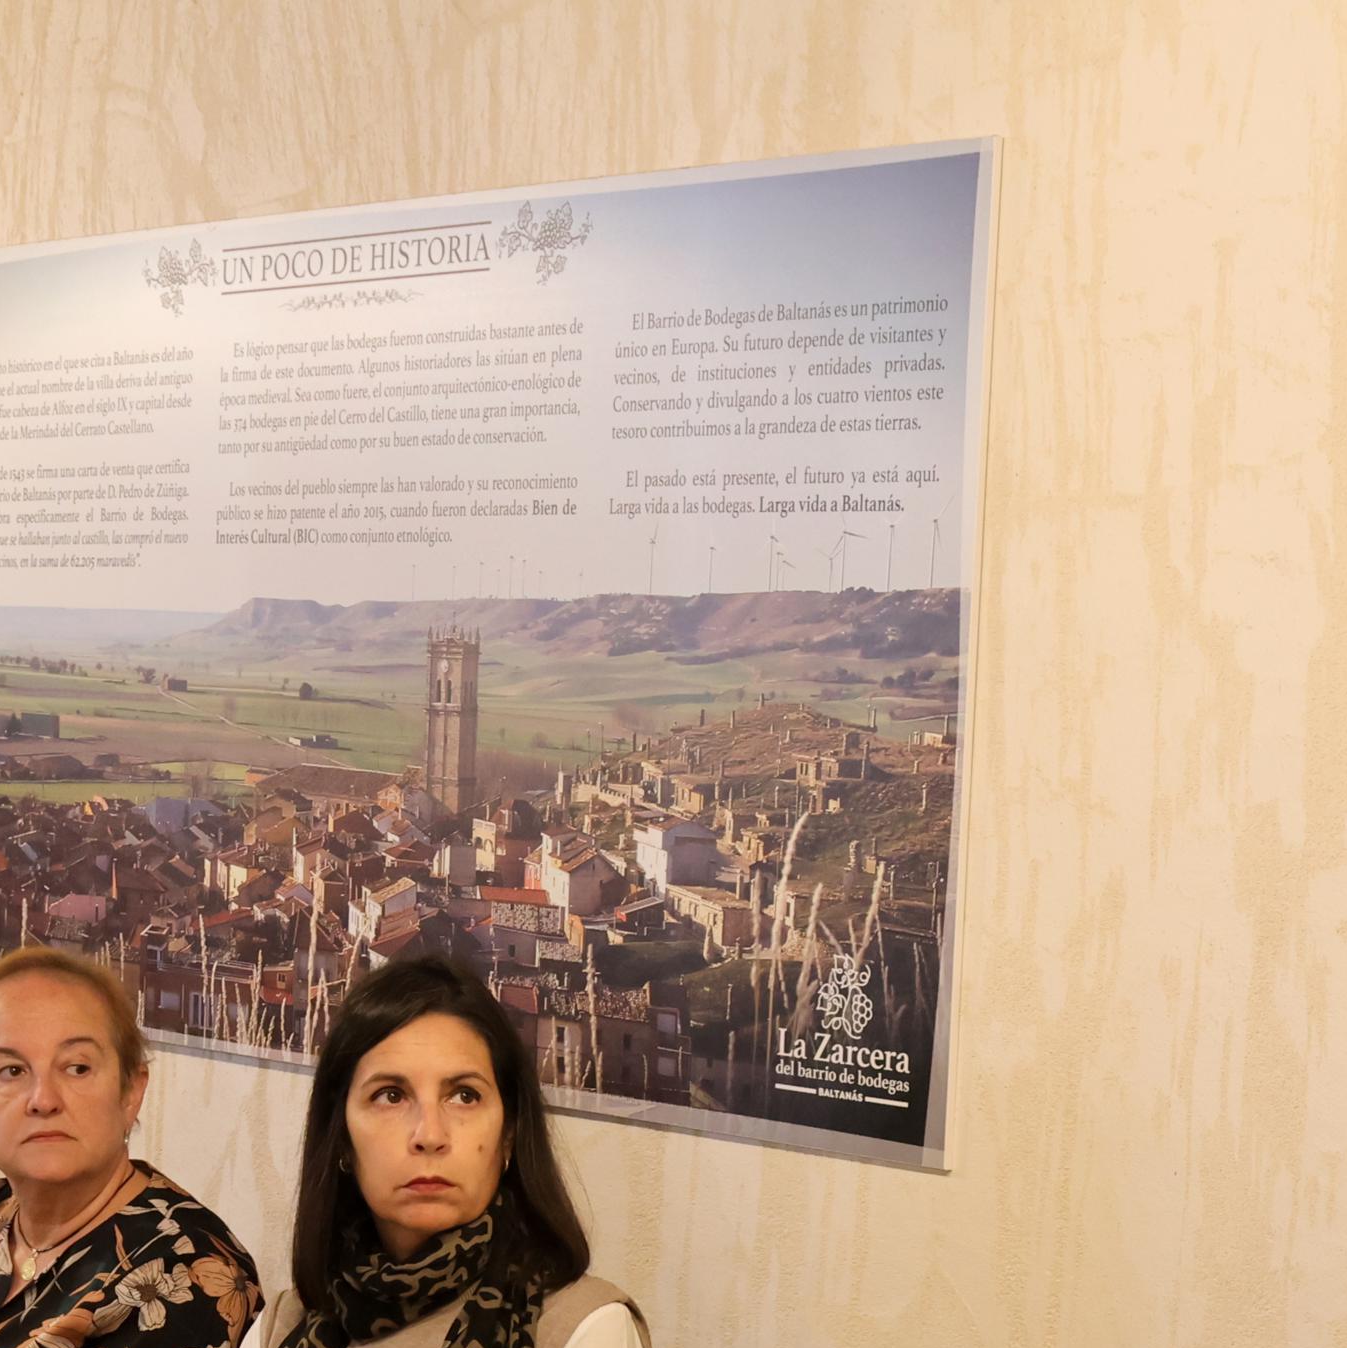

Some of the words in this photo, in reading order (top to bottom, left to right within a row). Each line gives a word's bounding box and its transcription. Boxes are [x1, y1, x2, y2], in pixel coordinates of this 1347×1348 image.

[222, 256, 254, 285] UN
[261, 249, 323, 281] POCO
[331, 245, 363, 275] DE
[370, 233, 490, 271] HISTORIA
[632, 312, 645, 330] El
[648, 312, 684, 329] Barrio
[686, 309, 702, 326] de
[705, 308, 755, 329] Bodegas
[757, 305, 774, 322] de
[777, 302, 831, 321] Baltanás
[833, 306, 848, 317] es
[850, 304, 868, 316] un
[872, 295, 948, 321] patrimonio
[233, 343, 245, 358] Es
[245, 341, 275, 361] lógico
[276, 342, 309, 359] pensar
[309, 341, 329, 357] que
[331, 335, 345, 351] las
[346, 333, 388, 352] bodegas
[389, 331, 424, 347] fueron
[489, 324, 535, 339] bastante
[537, 324, 567, 336] antes
[569, 319, 584, 334] de
[616, 342, 648, 358] único
[651, 344, 667, 356] en
[672, 338, 717, 358] Europa.
[723, 336, 739, 352] Su
[744, 334, 783, 351] futuro
[788, 329, 844, 353] depende
[848, 328, 866, 345] de
[870, 326, 933, 344] visitantes
[938, 329, 947, 346] y
[220, 367, 229, 383] la
[231, 366, 258, 381] firma
[260, 364, 273, 380] de
[275, 368, 295, 379] este
[297, 362, 355, 378] documento.
[357, 358, 401, 378] Algunos
[404, 353, 472, 371] historiadores
[476, 351, 491, 366] las
[494, 349, 529, 365] sitúan
[532, 353, 546, 363] en
[550, 347, 583, 367] plena
[615, 368, 660, 385] vecinos,
[670, 365, 687, 382] de
[698, 363, 776, 381] instituciones
[788, 365, 797, 382] y
[808, 357, 871, 376] entidades
[885, 354, 944, 378] privadas.
[219, 392, 247, 411] época
[247, 387, 293, 405] medieval.
[294, 387, 312, 402] Sea
[313, 390, 341, 401] como
[342, 384, 371, 399] fuere,
[372, 382, 382, 398] el
[383, 382, 430, 399] conjunto
[567, 372, 582, 387] de
[613, 393, 691, 412] Conservando
[695, 398, 703, 414] y
[708, 389, 777, 412] divulgando
[781, 394, 789, 405] a
[794, 388, 813, 405] los
[817, 391, 858, 404] cuatro
[864, 385, 911, 402] vientos
[917, 387, 943, 400] este
[612, 427, 647, 439] tesoro
[650, 419, 731, 438] contribuimos
[734, 424, 741, 435] a
[744, 418, 756, 435] la
[759, 417, 816, 440] grandeza
[819, 416, 837, 432] de
[840, 419, 871, 432] estas
[876, 414, 921, 430] tierras.
[218, 443, 243, 454] tanto
[243, 442, 260, 457] por
[261, 442, 273, 452] su
[273, 434, 329, 455] antigüedad
[329, 439, 358, 449] como
[359, 438, 378, 453] por
[379, 437, 391, 448] su
[393, 432, 419, 447] buen
[421, 430, 456, 446] estado
[457, 430, 471, 444] de
[626, 470, 639, 487] El
[645, 470, 686, 492] pasado
[693, 469, 715, 486] está
[723, 473, 778, 491] presente,
[784, 467, 797, 484] el
[804, 467, 844, 484] futuro
[850, 472, 866, 488] ya
[873, 466, 898, 483] está
[906, 465, 939, 488] aquí.
[215, 505, 251, 525] público
[253, 510, 264, 520] se
[266, 504, 288, 519] hizo
[289, 508, 326, 524] patente
[328, 503, 339, 519] el
[341, 504, 361, 518] año
[389, 502, 429, 517] cuando
[431, 501, 467, 517] fueron
[470, 500, 529, 516] declaradas
[532, 500, 558, 515] Bien
[562, 499, 577, 515] de
[610, 498, 641, 519] Larga
[645, 497, 669, 514] vida
[672, 503, 679, 513] a
[682, 496, 699, 514] las
[703, 496, 755, 518] bodegas.
[760, 496, 795, 518] Larga
[799, 495, 826, 512] vida
[830, 501, 838, 512] a
[843, 494, 904, 511] Baltanás.
[215, 530, 250, 544] Interés
[250, 528, 292, 544] Cultural
[293, 528, 319, 544] (BIC)
[320, 533, 349, 543] como
[349, 528, 395, 545] conjunto
[396, 527, 453, 547] etnológico.
[777, 1028, 807, 1060] La
[813, 1032, 911, 1074] Zarcera
[775, 1059, 794, 1076] del
[798, 1061, 837, 1082] barrio
[839, 1068, 855, 1084] de
[858, 1070, 910, 1095] bodegas
[818, 1087, 864, 1102] BALTANÁS
